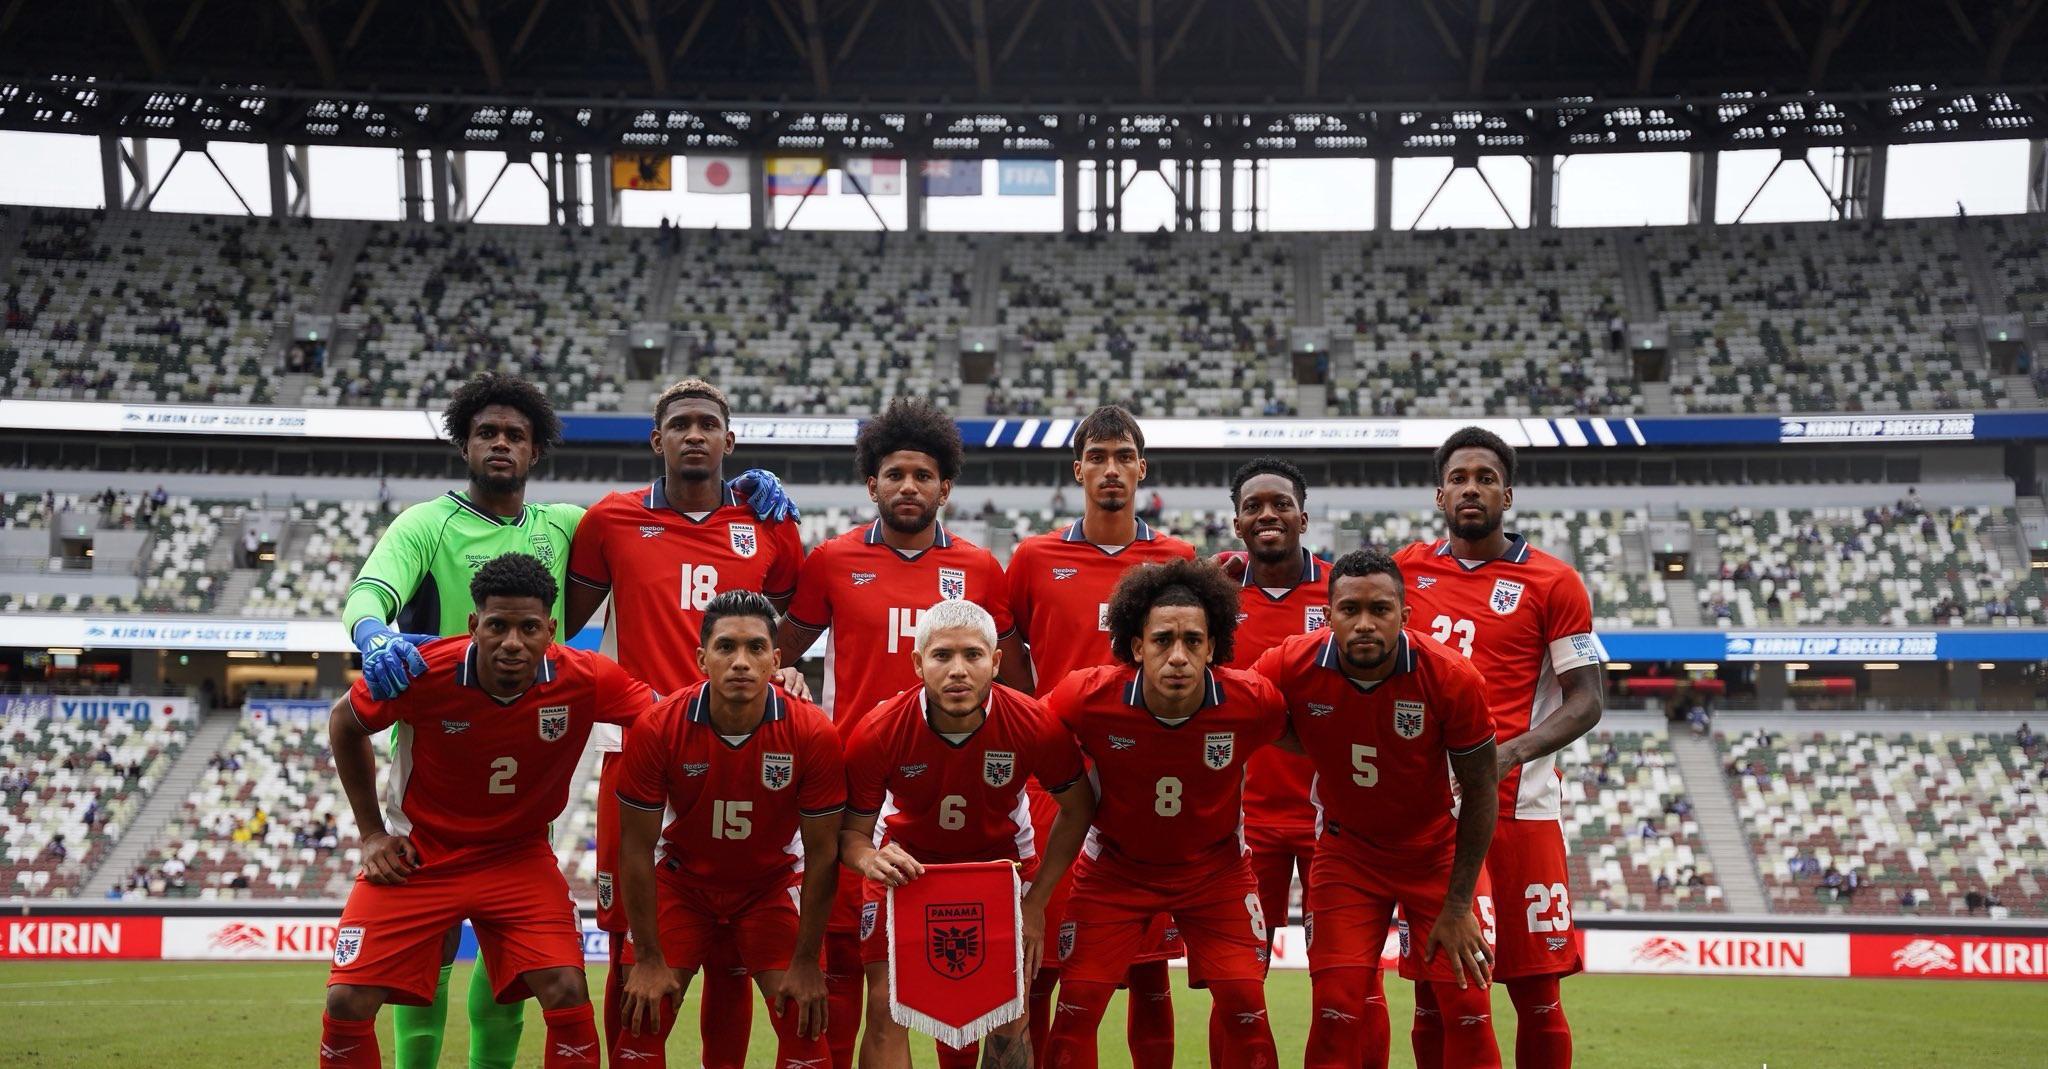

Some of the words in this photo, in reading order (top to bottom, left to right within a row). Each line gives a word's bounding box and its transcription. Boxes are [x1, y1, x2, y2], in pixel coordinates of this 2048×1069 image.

[1004, 168, 1048, 185] FIFA
[146, 414, 187, 424] KIRIN
[191, 415, 218, 425] CUP
[224, 416, 273, 426] SOCCER
[1247, 429, 1284, 438] KIRIN
[1804, 421, 1849, 437] KIRIN
[1849, 421, 1882, 436] CUP
[1882, 420, 1940, 436] SOCCER
[680, 563, 718, 611] 18
[110, 627, 155, 638] KIRIN
[161, 628, 191, 639] CUP
[197, 629, 252, 640] SOCCER
[888, 607, 926, 653] 14
[1431, 614, 1476, 659] 23
[1752, 639, 1801, 655] KIRIN
[1801, 639, 1837, 654] CUP
[1837, 638, 1900, 655] SOCCER
[1307, 702, 1335, 711] Reebok
[441, 720, 471, 728] Reebok
[1108, 735, 1136, 746] Reebok
[489, 756, 518, 794] 2
[900, 763, 928, 772] Reebok
[1352, 743, 1378, 788] 5
[938, 795, 968, 831] 6
[1155, 776, 1183, 817] 8
[712, 799, 753, 840] 15
[1244, 893, 1267, 941] 8
[1477, 895, 1496, 945] 5
[1525, 883, 1570, 933] 23
[8, 922, 121, 955] KIRIN
[276, 925, 338, 952] KIR
[1698, 941, 1804, 968] KIRIN
[1962, 942, 2048, 975] KIRI
